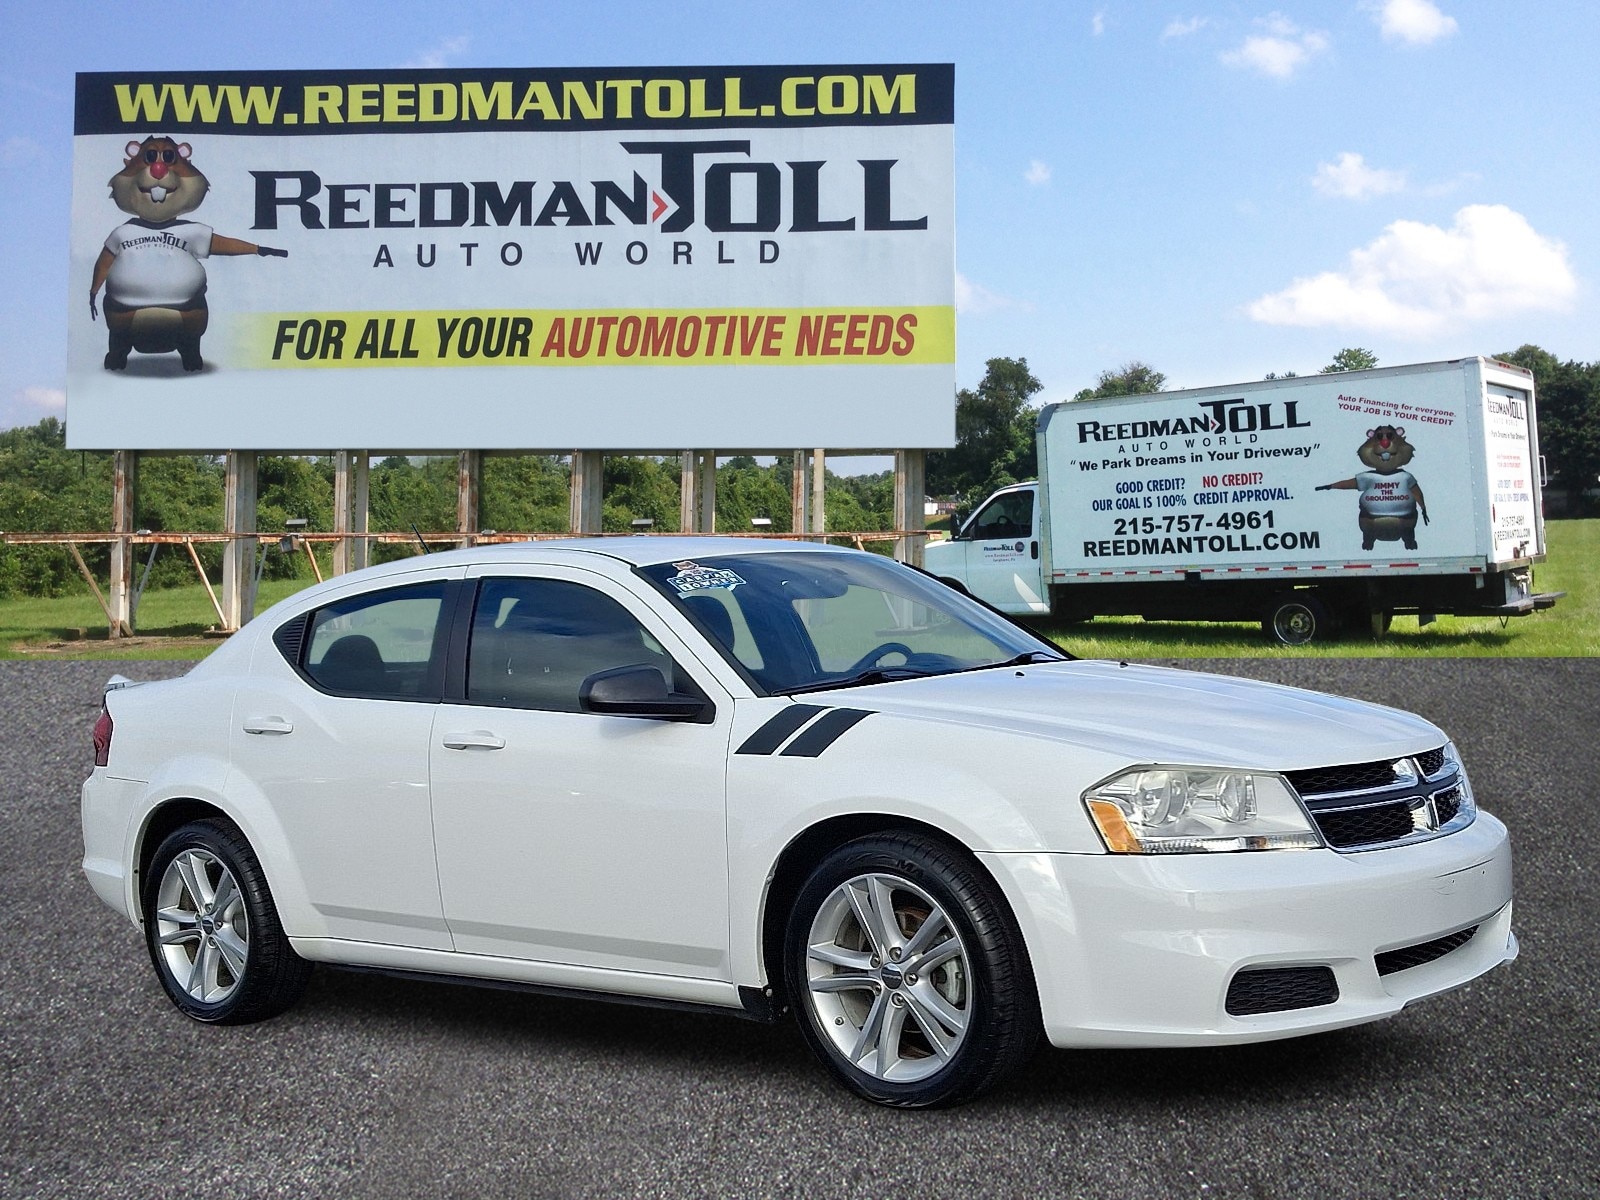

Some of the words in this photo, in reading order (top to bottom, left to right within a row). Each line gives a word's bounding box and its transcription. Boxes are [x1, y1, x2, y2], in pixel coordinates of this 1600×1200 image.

[114, 74, 917, 126] WWW.REEDMANTOLL.COM
[373, 242, 523, 269] AUTO
[574, 240, 781, 266] WORLD
[272, 320, 347, 360] FOR
[354, 318, 420, 359] ALL
[437, 317, 533, 358] YOUR
[541, 316, 787, 358] AUTOMOTIVE
[795, 313, 919, 356] NEEDS
[1338, 403, 1361, 412] YOUR
[1363, 407, 1381, 415] JOB
[1394, 412, 1418, 421] YOUR
[1421, 415, 1454, 426] CREDIT
[1359, 397, 1399, 410] Financing
[1118, 441, 1168, 454] AUTO
[1185, 433, 1259, 448] WORLD
[1102, 458, 1132, 470] Park
[1136, 454, 1187, 467] Dreams
[1191, 453, 1203, 462] in
[1207, 450, 1240, 463] Your
[1116, 480, 1144, 494] GOOD
[1147, 477, 1186, 492] CREDIT?
[1202, 475, 1219, 488] NO
[1222, 472, 1263, 487] CREDIT?
[1092, 499, 1113, 511] OUR
[1115, 497, 1141, 510] GOAL
[1143, 496, 1153, 509] IS
[1156, 494, 1187, 507] 100%
[1193, 490, 1229, 506] CREDIT
[1232, 487, 1294, 503] APPROVAL.
[1113, 510, 1275, 536] 215-757-4961
[1083, 531, 1321, 557] REEDMANTOLL.COM
